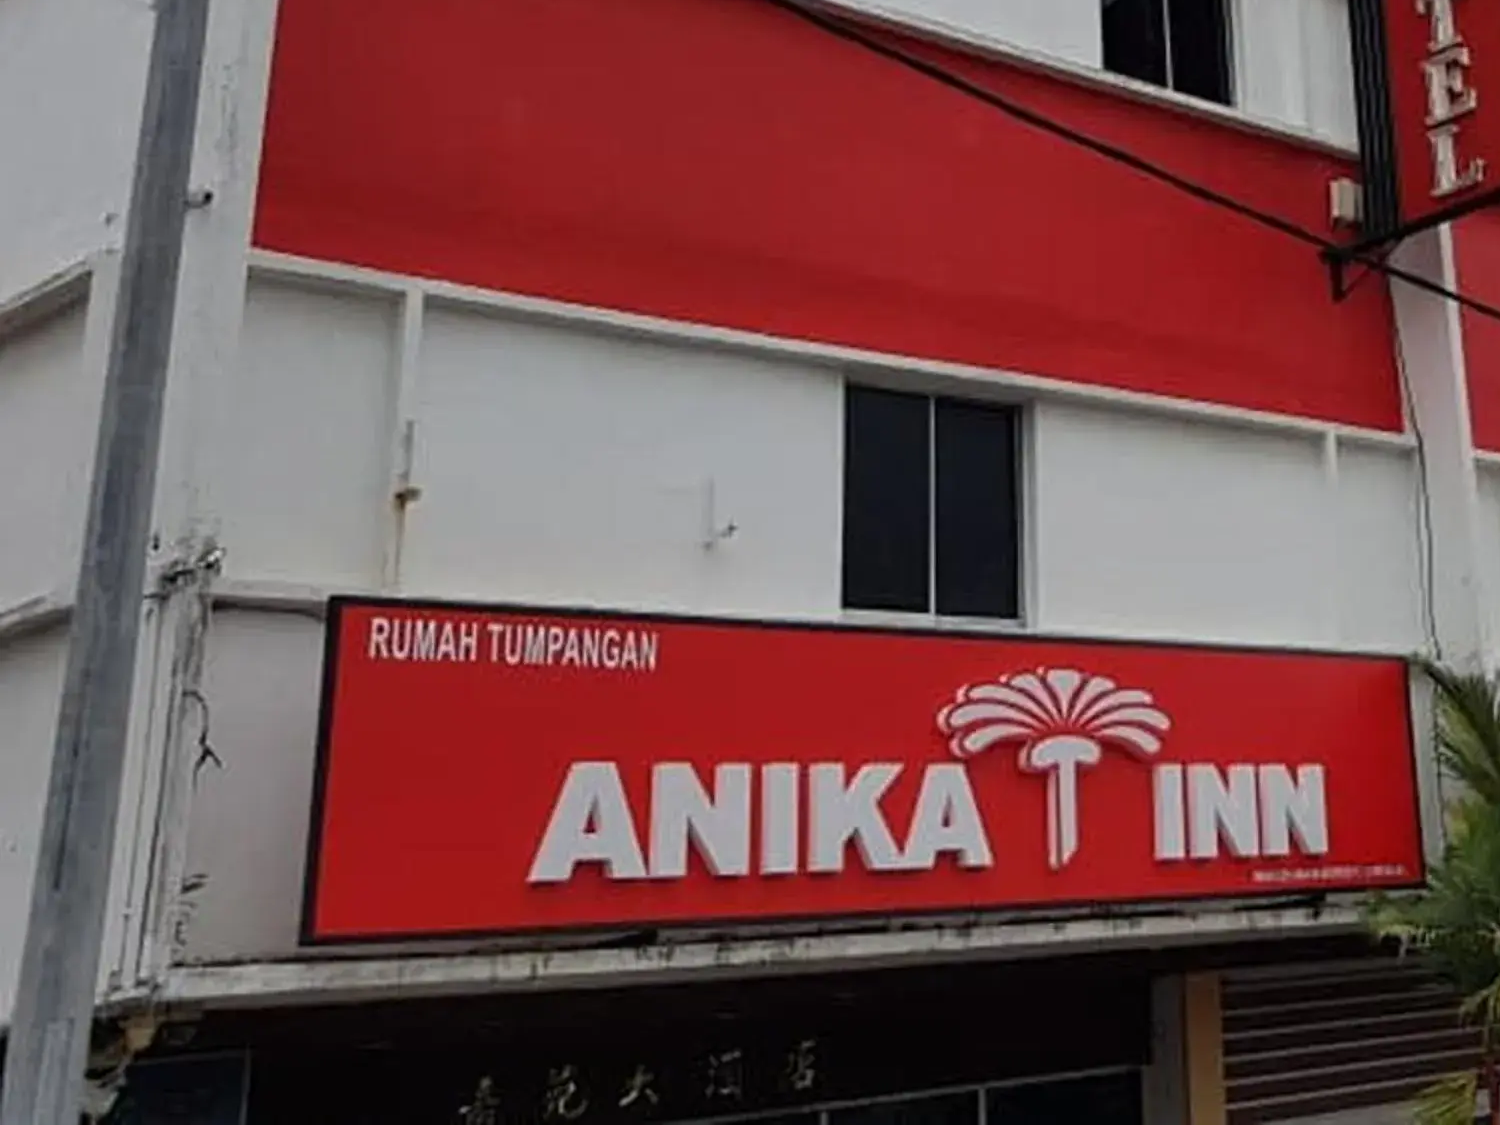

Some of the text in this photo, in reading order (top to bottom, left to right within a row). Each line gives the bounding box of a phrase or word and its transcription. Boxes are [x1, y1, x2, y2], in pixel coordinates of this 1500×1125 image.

[369, 616, 659, 670] RUMAH TUMPANGAN
[525, 761, 1329, 883] ANIKA INN
